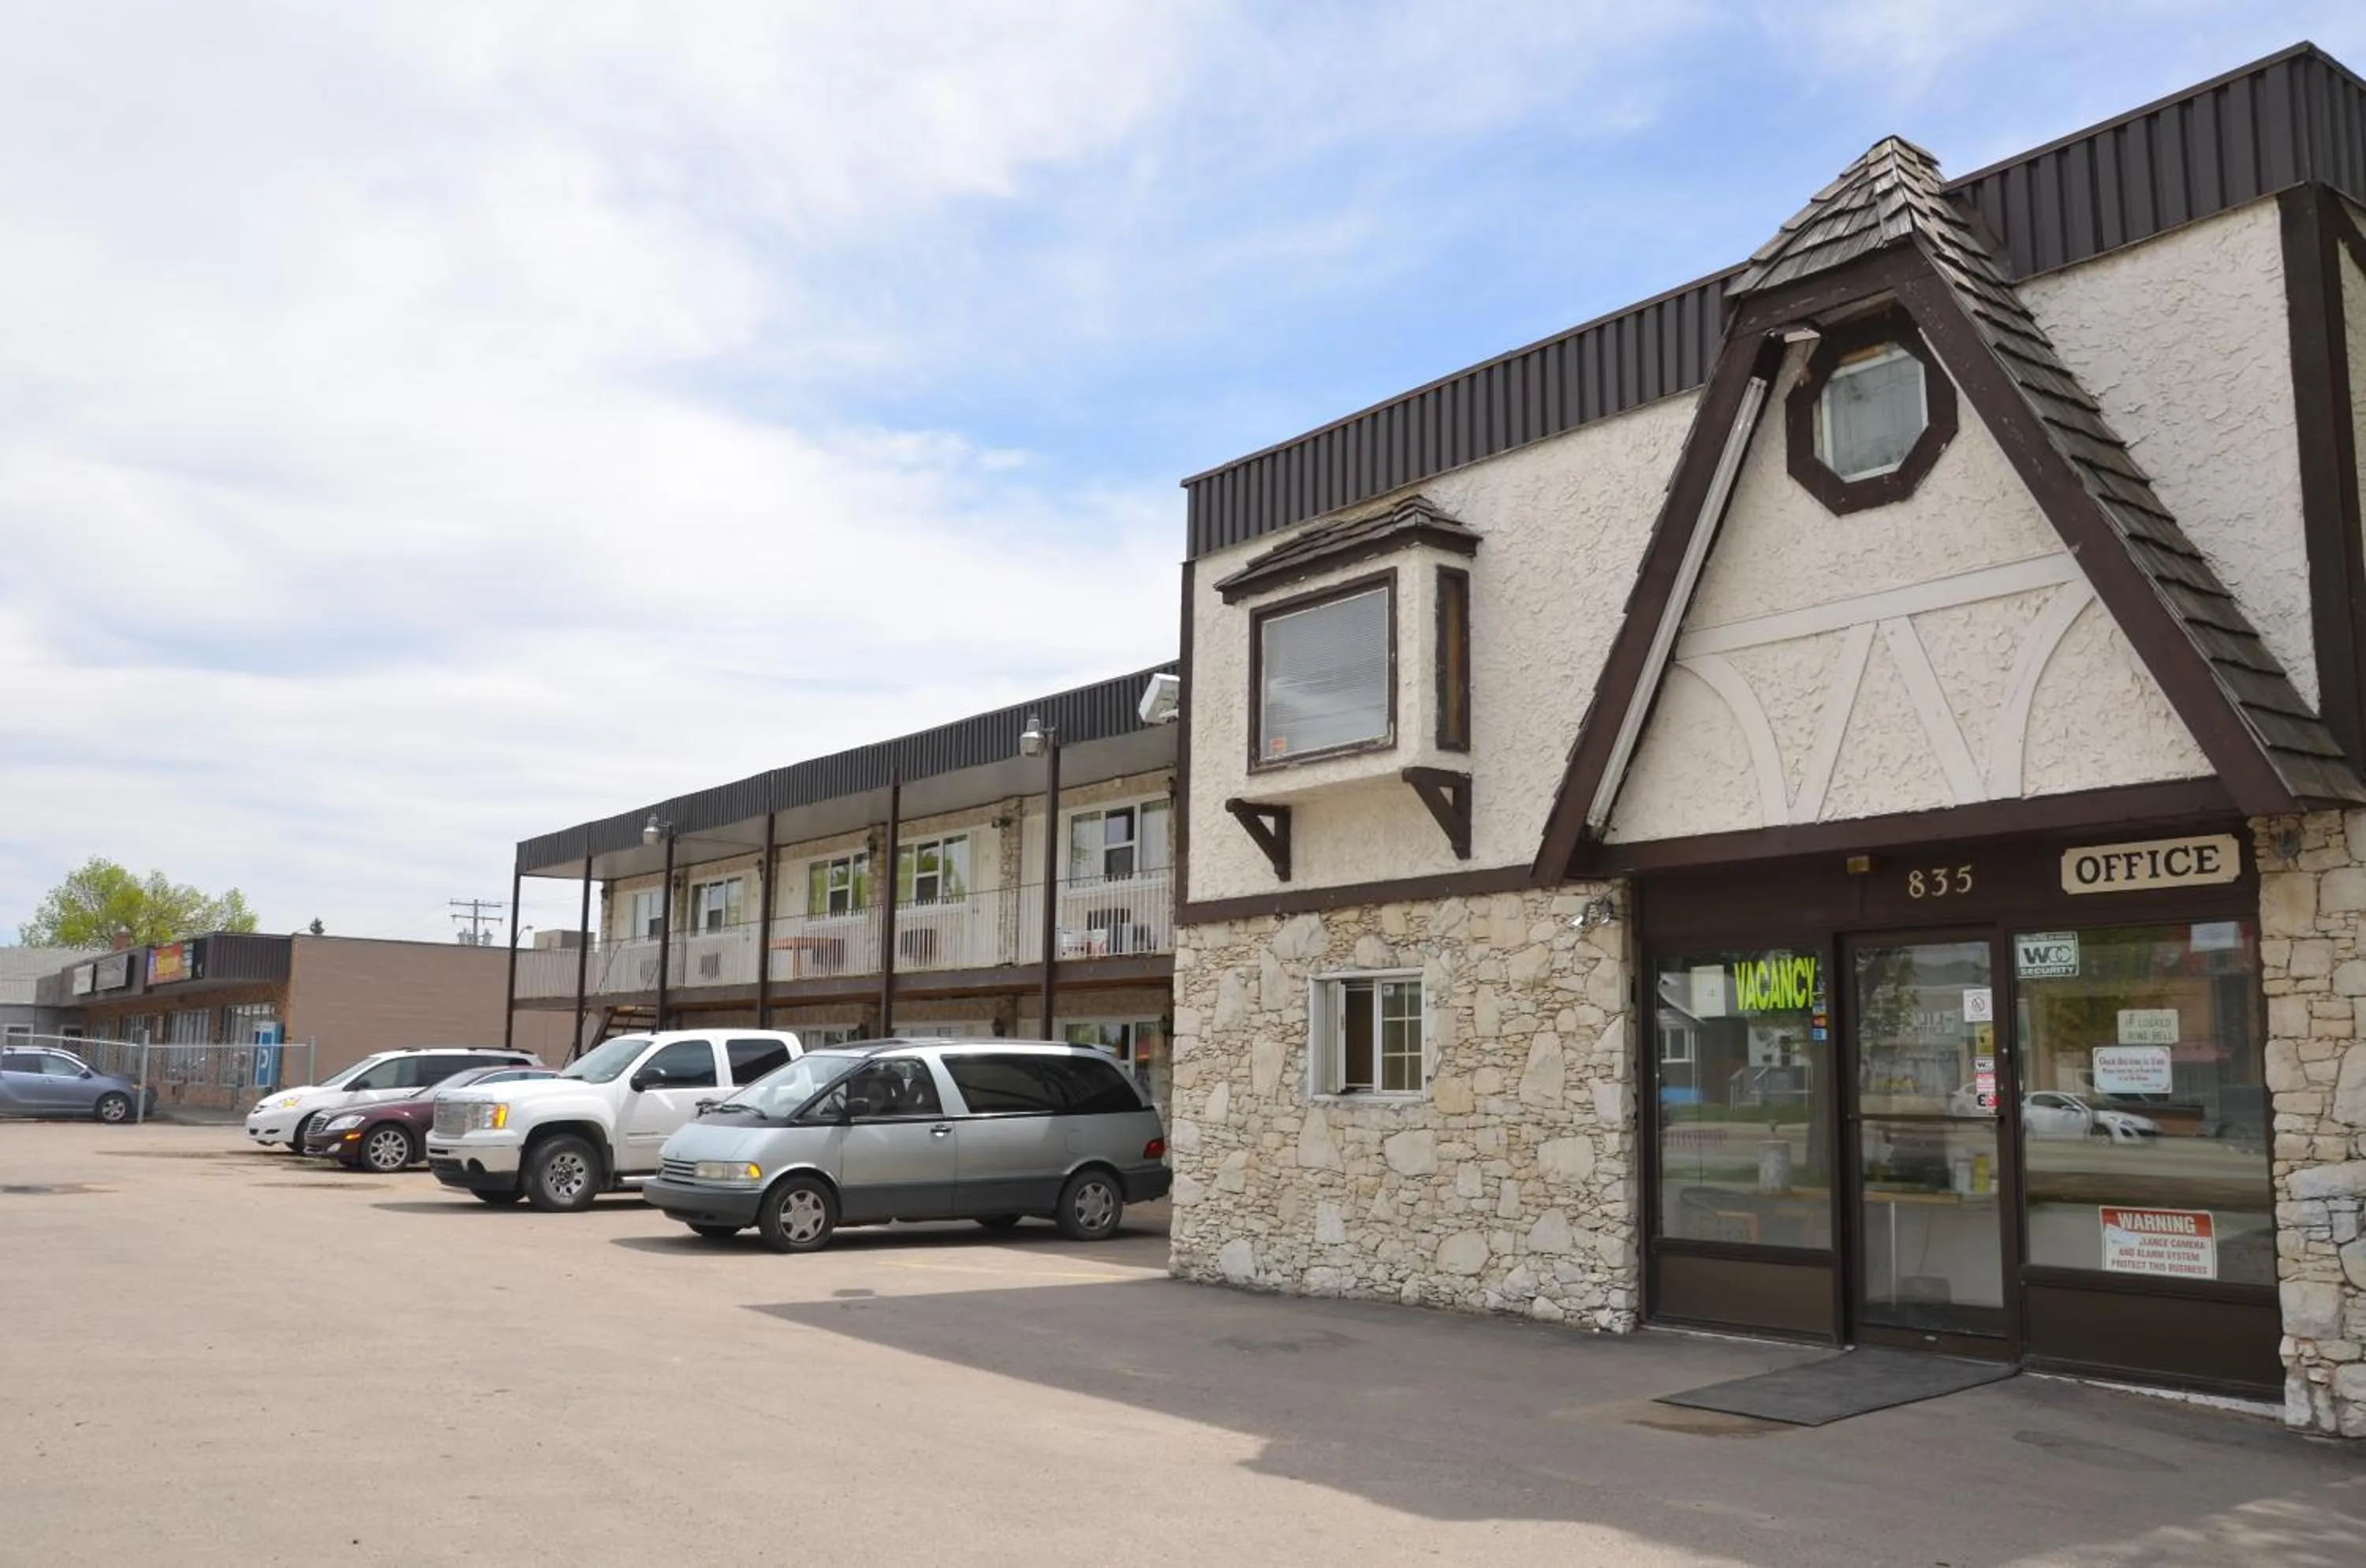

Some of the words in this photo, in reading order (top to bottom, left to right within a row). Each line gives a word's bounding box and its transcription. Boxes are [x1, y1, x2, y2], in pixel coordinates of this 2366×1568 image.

[2075, 844, 2221, 884] OFFICE
[1909, 865, 1972, 898] 835
[2019, 965, 2076, 976] SECURITY
[1733, 957, 1816, 1010] VACANCY
[2117, 1212, 2196, 1233] WARNING
[2170, 1238, 2205, 1249] CAMERA
[2119, 1248, 2134, 1256] AND
[2137, 1249, 2164, 1258] ALARM
[2167, 1250, 2200, 1261] SYSTEM
[2111, 1260, 2145, 1270] PROTECT
[2149, 1261, 2166, 1271] THIS
[2169, 1263, 2207, 1275] BUSINESS
